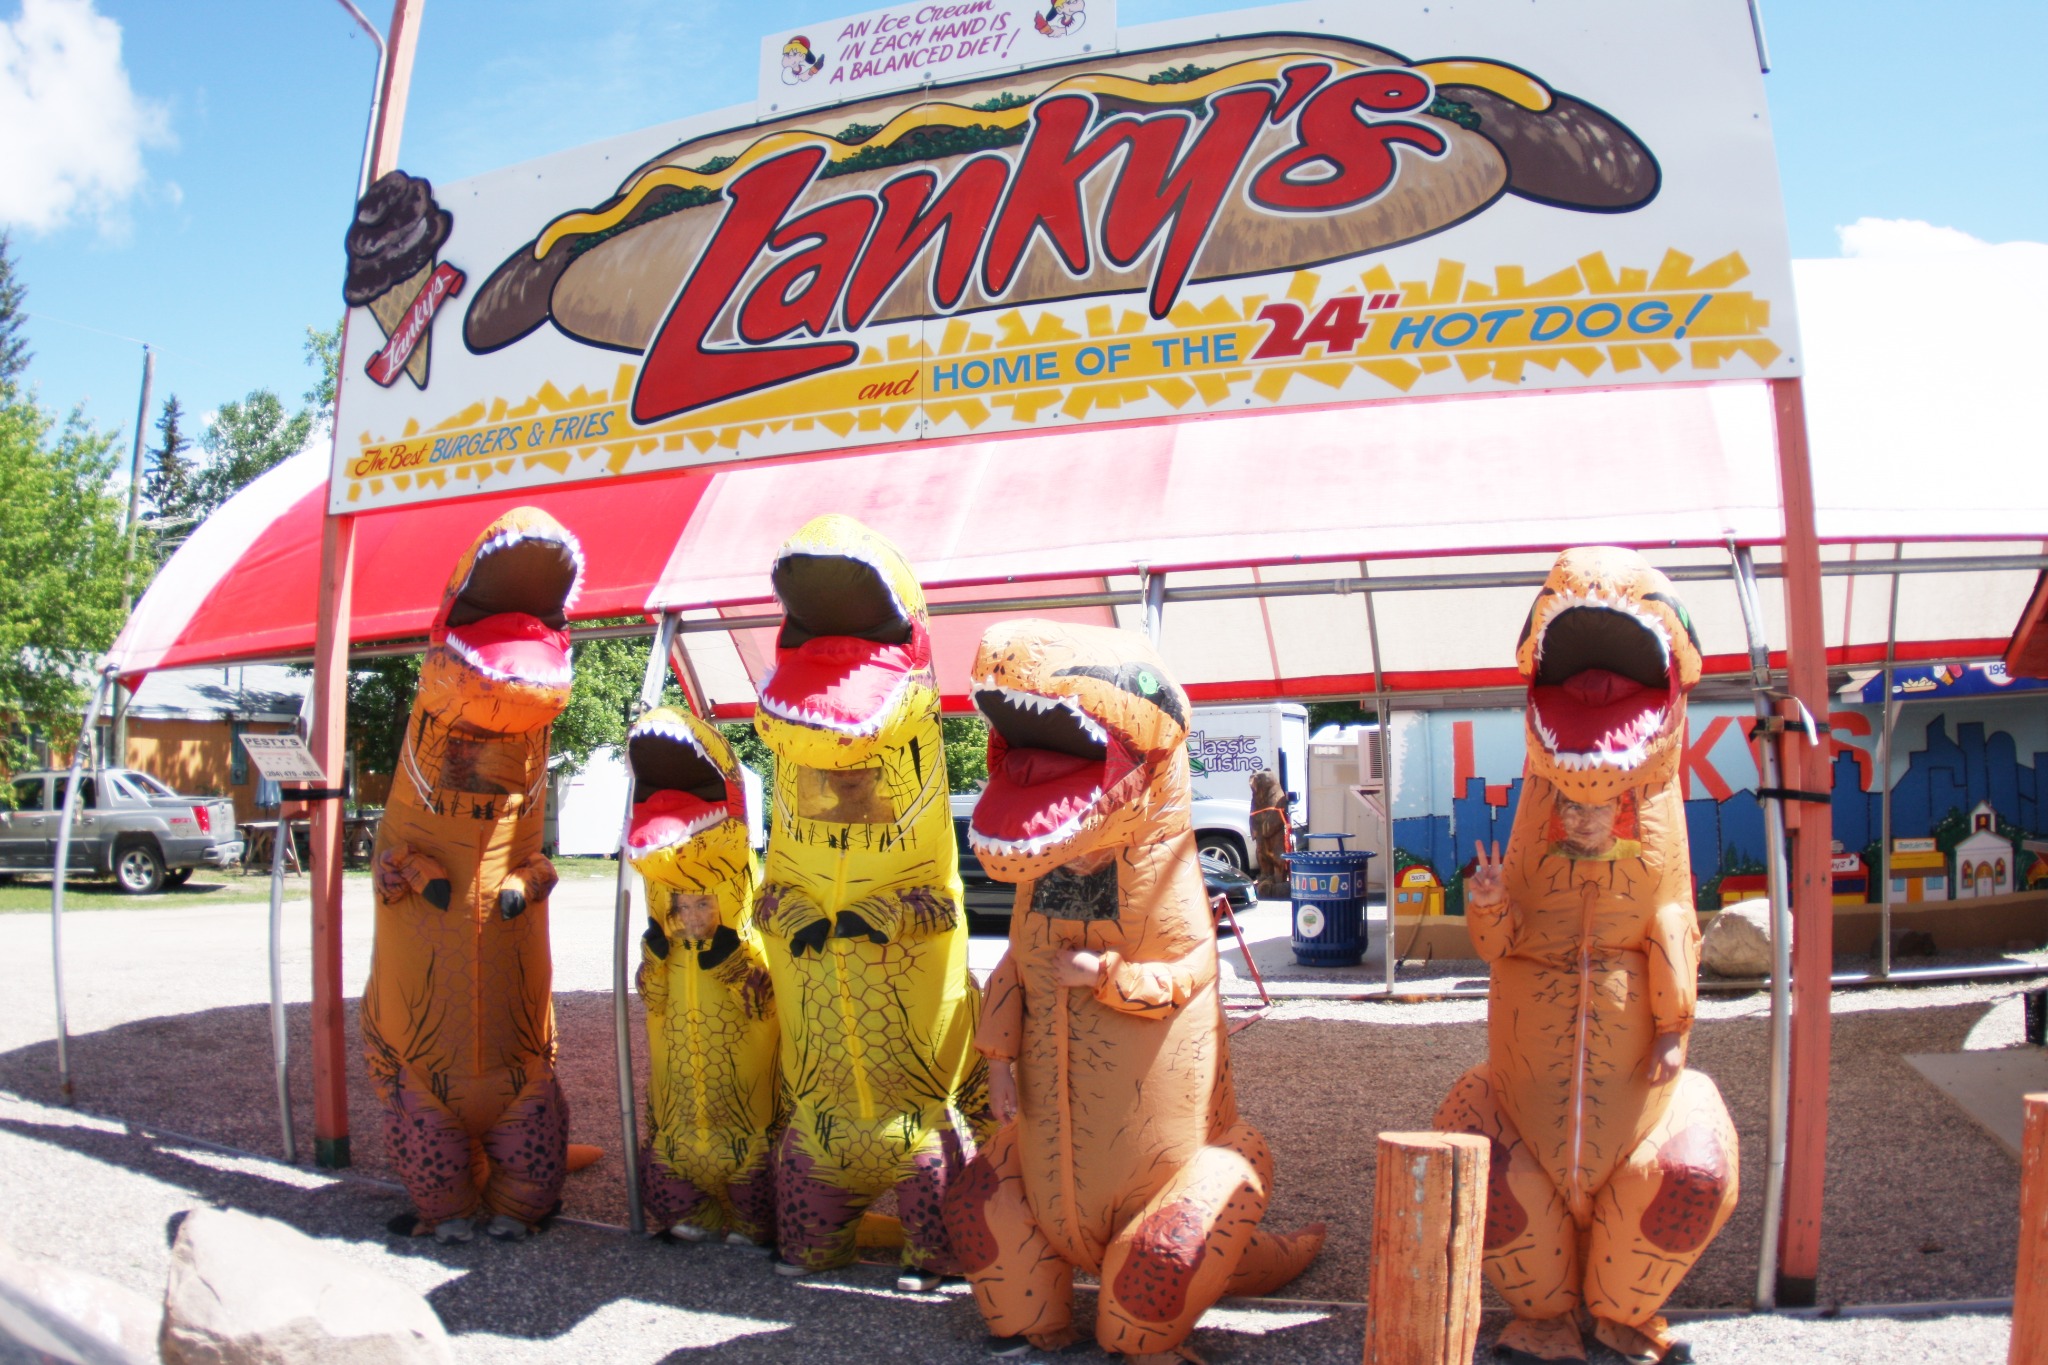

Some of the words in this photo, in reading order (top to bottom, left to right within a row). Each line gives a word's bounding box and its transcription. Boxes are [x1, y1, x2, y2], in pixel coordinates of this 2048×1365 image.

[836, 19, 872, 42] AN
[872, 13, 910, 36] Ice
[915, 0, 996, 25] Cream
[839, 41, 866, 62] IN
[869, 30, 923, 56] EACH
[929, 19, 986, 45] HAND
[989, 11, 1011, 31] IS
[829, 66, 844, 85] A
[849, 44, 952, 81] BALANCED
[957, 28, 1020, 59] DIET!
[632, 60, 1449, 425] Lanky's
[380, 275, 452, 384] Lanky's
[858, 369, 919, 400] and
[932, 351, 1060, 392] HOME
[1074, 343, 1132, 375] OF
[1152, 333, 1239, 368] THE
[1250, 293, 1401, 360] 24"
[1390, 307, 1526, 350] HOT
[1529, 294, 1714, 341] DOG!
[355, 450, 385, 477] The
[388, 443, 428, 469] Best
[429, 425, 523, 464] BURGERS
[527, 422, 545, 448] &
[549, 411, 615, 445] FRIES
[1988, 663, 2006, 676] 195
[243, 737, 300, 746] PESTY'S
